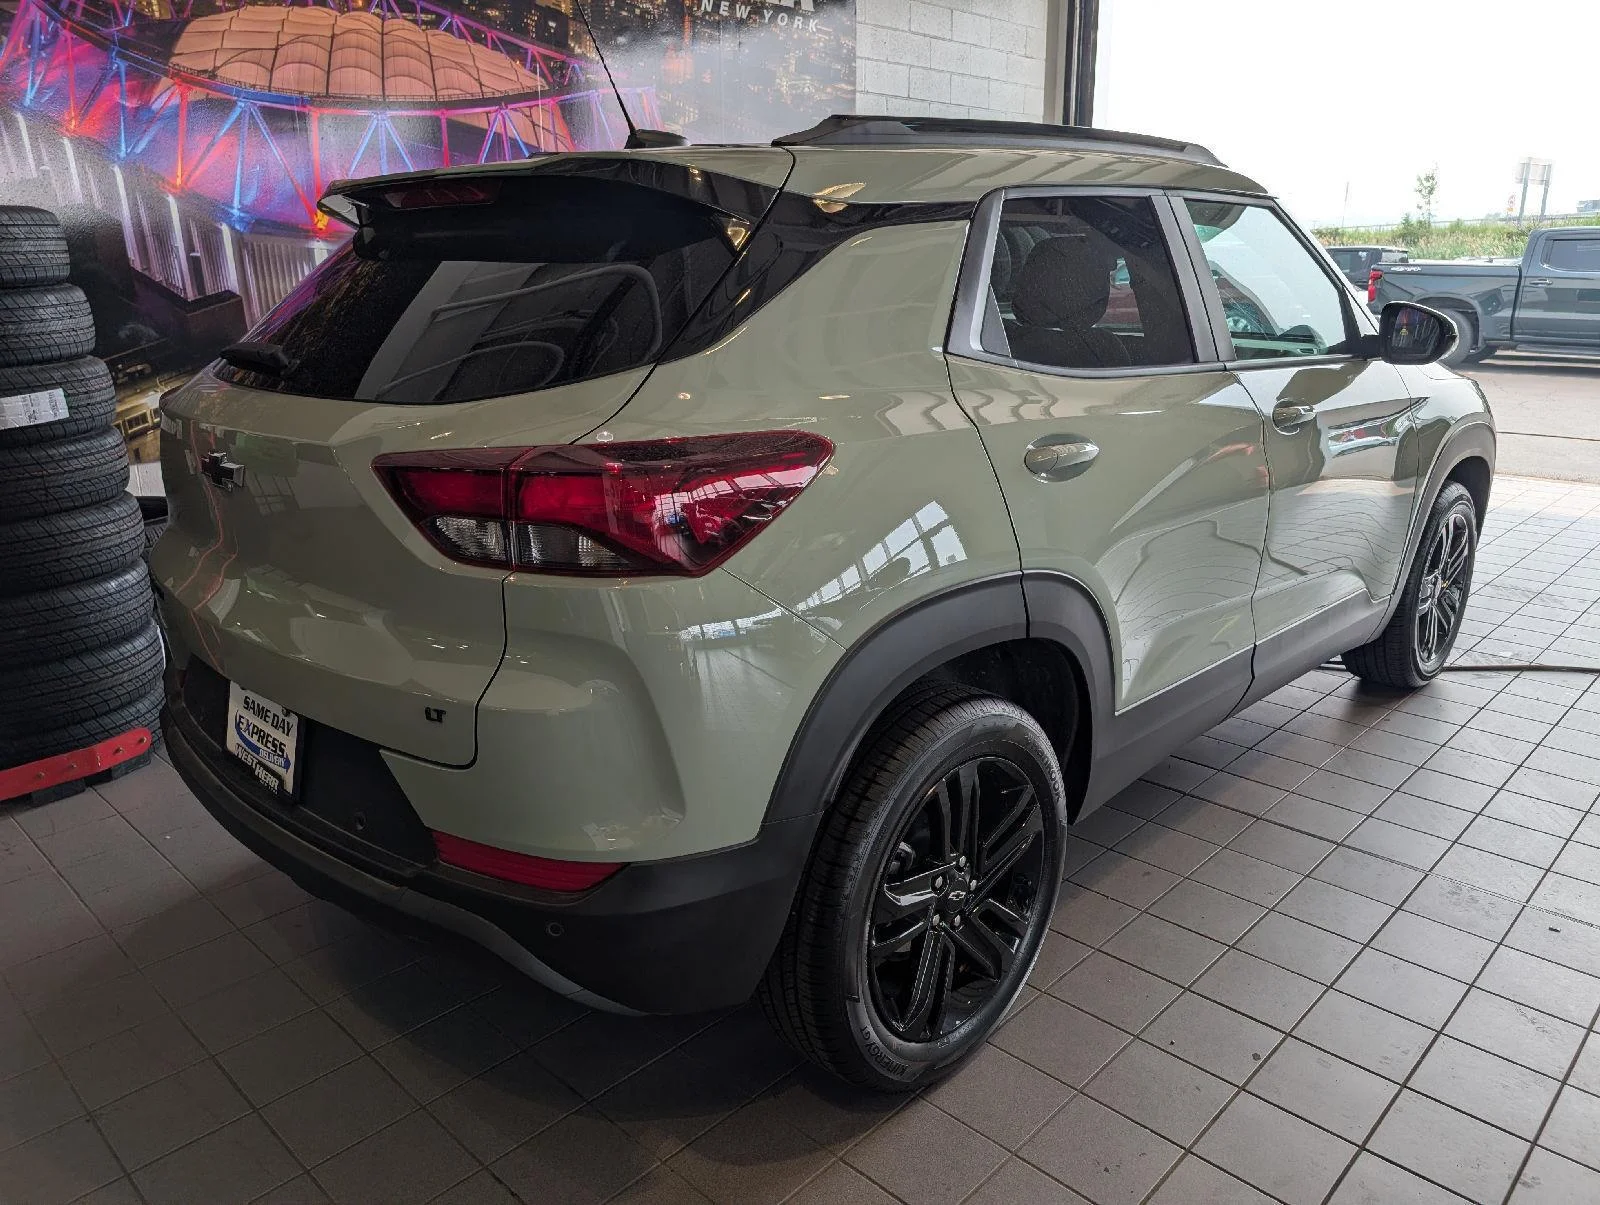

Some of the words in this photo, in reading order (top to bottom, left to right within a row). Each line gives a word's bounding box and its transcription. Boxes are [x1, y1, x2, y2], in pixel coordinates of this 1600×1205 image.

[701, 0, 751, 19] NEW
[763, 9, 819, 33] YORK
[243, 695, 272, 723] SAME
[271, 712, 294, 737] DAY
[425, 706, 447, 723] LT
[238, 714, 287, 756] EXPRESS
[235, 742, 260, 769] WEST
[259, 747, 286, 769] DELIVERY
[865, 1041, 908, 1077] KINERGY
